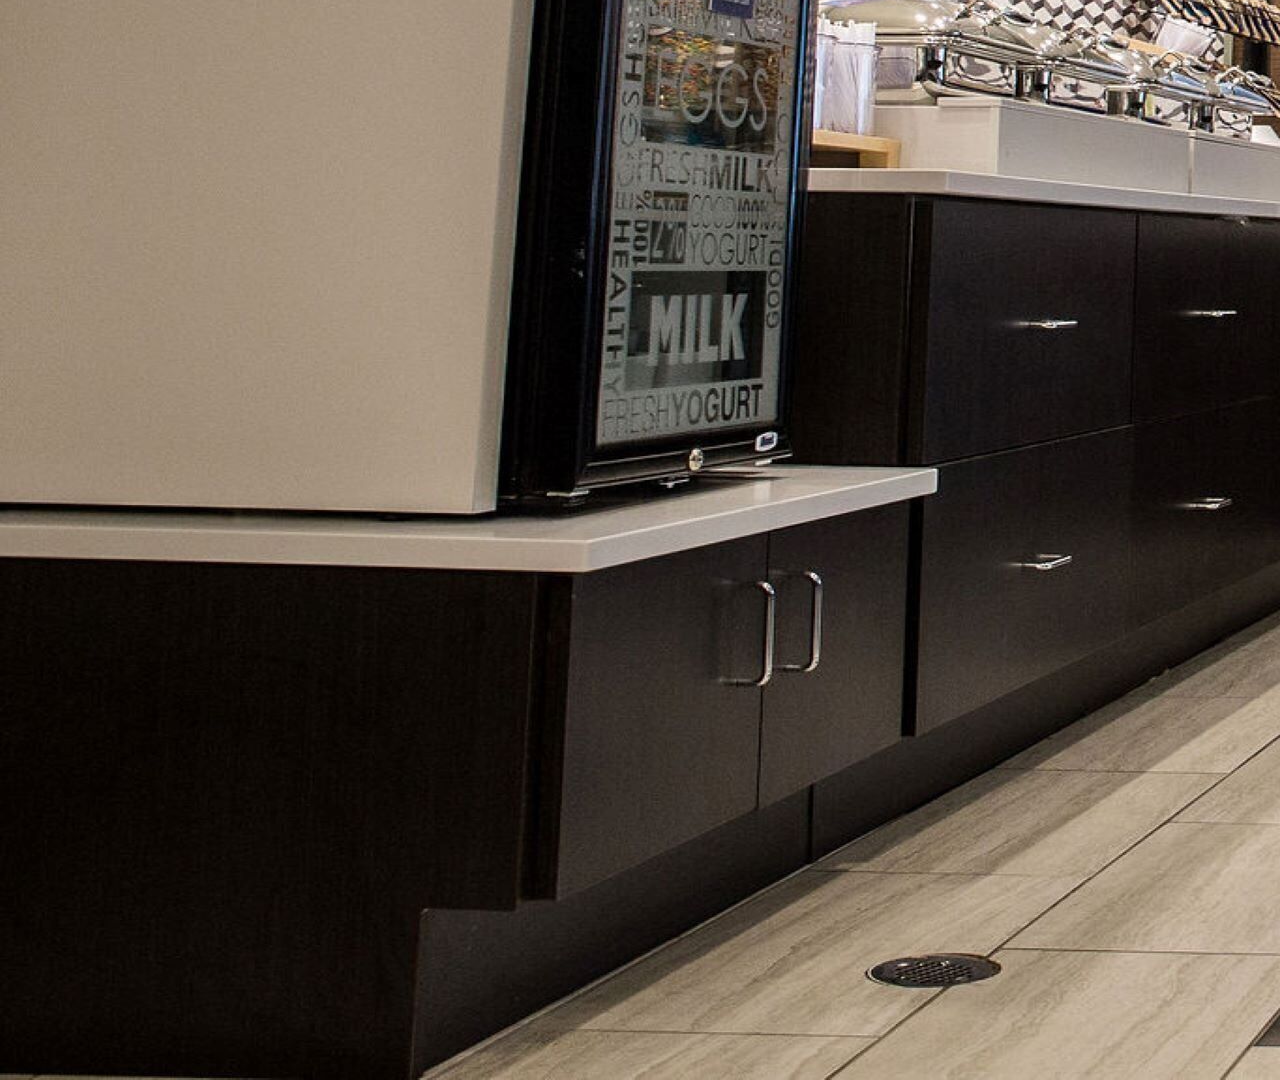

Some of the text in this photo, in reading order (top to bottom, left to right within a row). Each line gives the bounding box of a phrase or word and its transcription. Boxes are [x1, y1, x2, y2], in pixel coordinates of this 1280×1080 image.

[686, 232, 768, 266] YOGURT
[602, 219, 631, 395] HEALTHY
[647, 293, 748, 367] MILK
